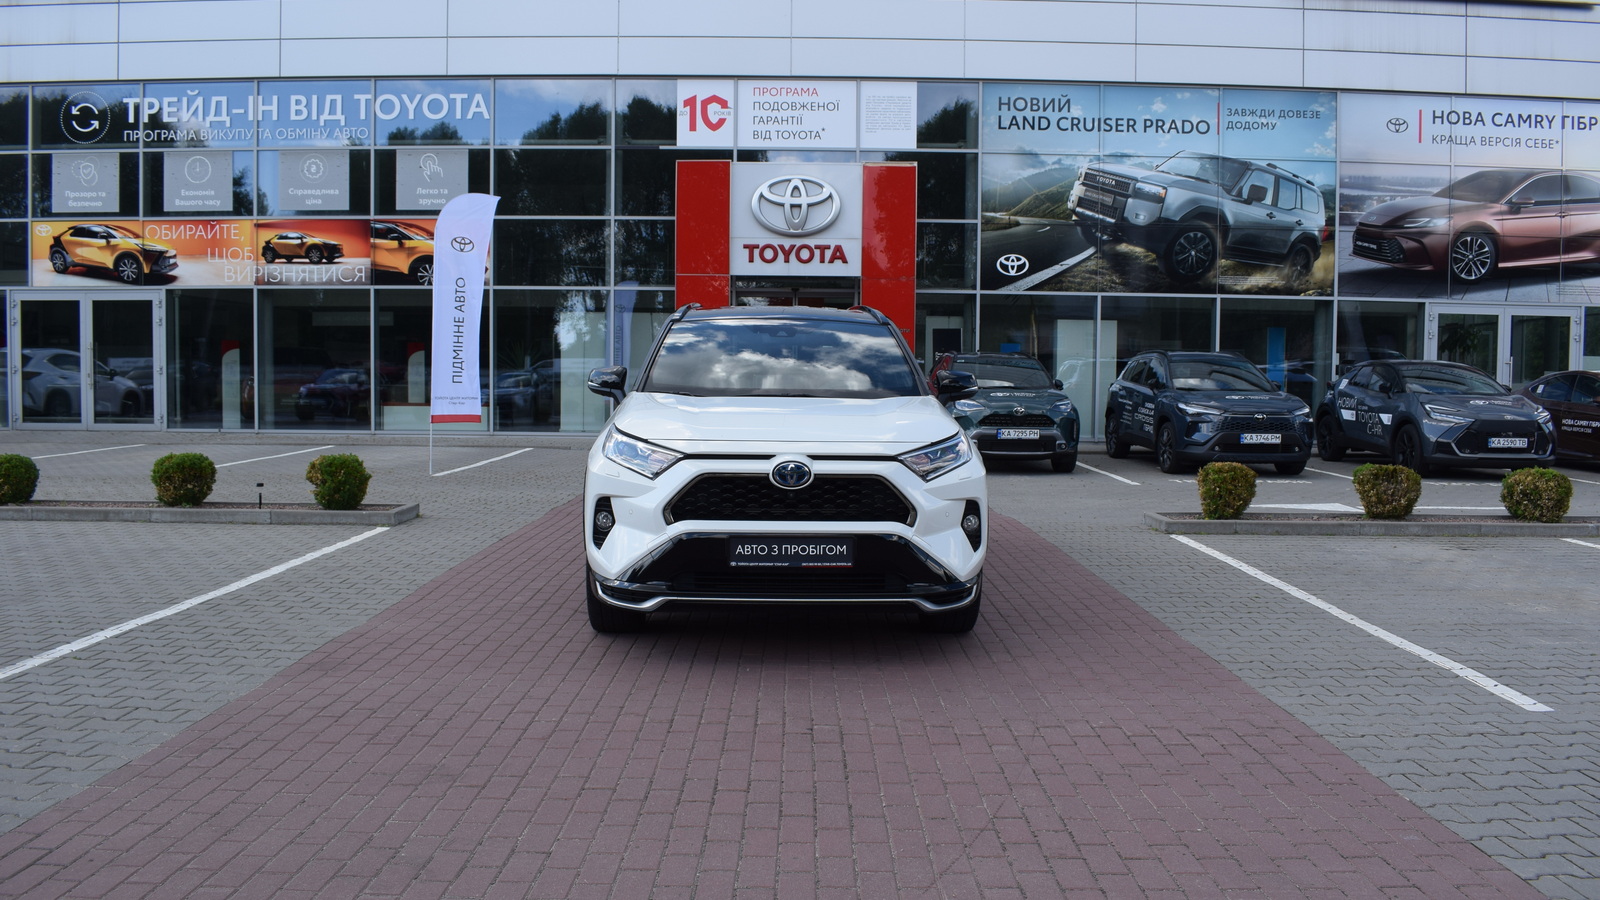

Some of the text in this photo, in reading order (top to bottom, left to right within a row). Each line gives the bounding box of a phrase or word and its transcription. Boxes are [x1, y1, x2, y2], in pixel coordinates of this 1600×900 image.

[753, 87, 819, 97] ПРОГРАМА
[123, 90, 491, 127] ТРЕЙД-ІН ВІД TOYOTA
[753, 99, 840, 112] ПОДОВЖЕНОЇ
[998, 95, 1071, 113] НОВИЙ
[753, 114, 803, 126] ГАРАНТІЇ
[1226, 107, 1321, 121] ЗАВЖДИ ДОВЕЗЕ
[1432, 110, 1485, 127] НОВА
[1491, 112, 1556, 130] CAMRY
[998, 115, 1211, 135] LAND CRUISER PRADO
[1226, 120, 1277, 132] ДОДОМУ
[123, 128, 369, 142] ПРОГРАМА ВИКУПУ ТА ОБМІНУ АВТО
[753, 131, 772, 141] ВІД
[1432, 134, 1476, 146] КРАЩА
[1480, 136, 1521, 148] ВЕРСІЯ
[1096, 176, 1116, 185] TOYOTA
[65, 191, 97, 200] Прозоро
[288, 188, 340, 197] Справедлива
[416, 187, 438, 195] Легко
[305, 197, 322, 205] ціна
[418, 197, 446, 206] зручно
[145, 222, 245, 241] ОБИРАЙТЕ,
[207, 247, 254, 264] ЩОБ
[743, 243, 848, 264] TOYOTA
[224, 265, 366, 283] ВИРІЗНЯТИСЯ
[452, 277, 466, 384] ПІДМІННЕ АВТО
[1337, 396, 1358, 408] НОВИЙ
[1358, 411, 1380, 423] TOYOTA
[1367, 423, 1383, 435] C-HR
[1244, 434, 1281, 442] KA 3746 PM
[735, 544, 847, 555] АВТО З ПРОБІГОМ
